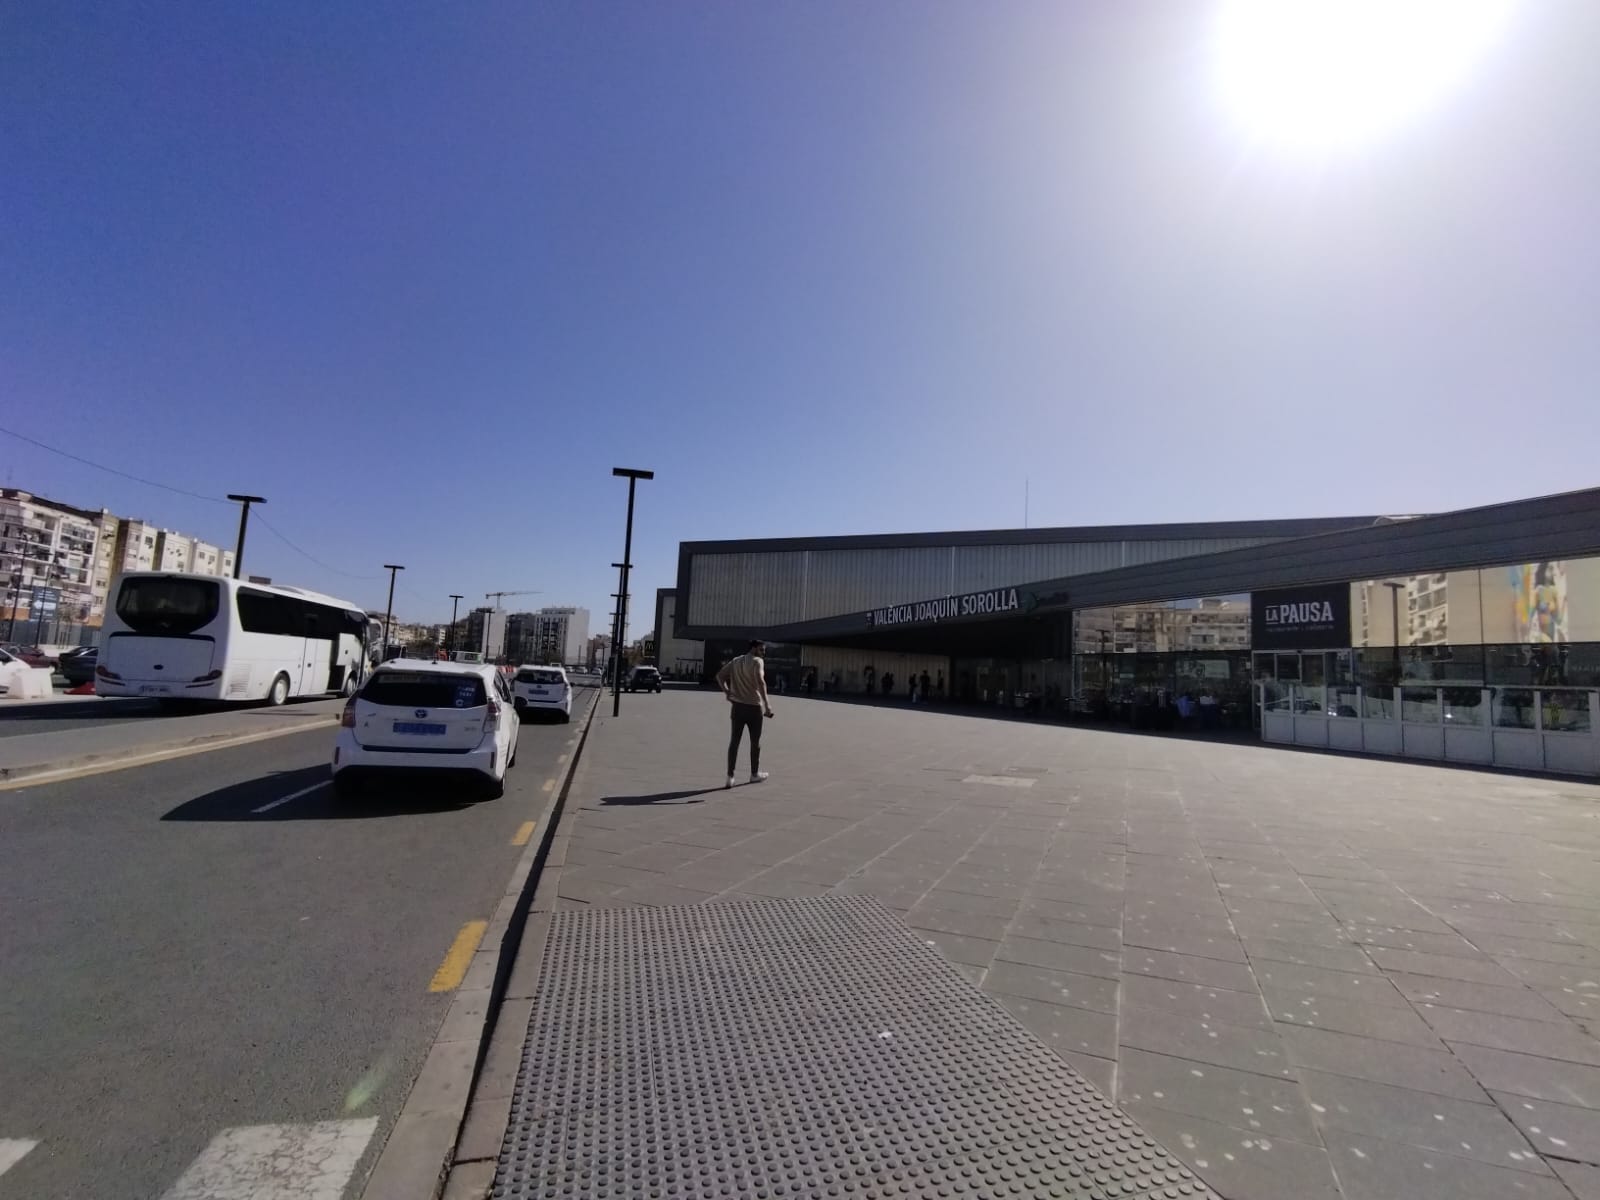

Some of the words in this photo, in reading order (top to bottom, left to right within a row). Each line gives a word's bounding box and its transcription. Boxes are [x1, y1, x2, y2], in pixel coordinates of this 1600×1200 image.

[874, 604, 913, 626] VALÈNCIA
[914, 594, 959, 623] JOAQUÍN
[961, 588, 1019, 615] SOROLLA
[1265, 609, 1279, 621] LA
[1279, 601, 1335, 624] PAUSA
